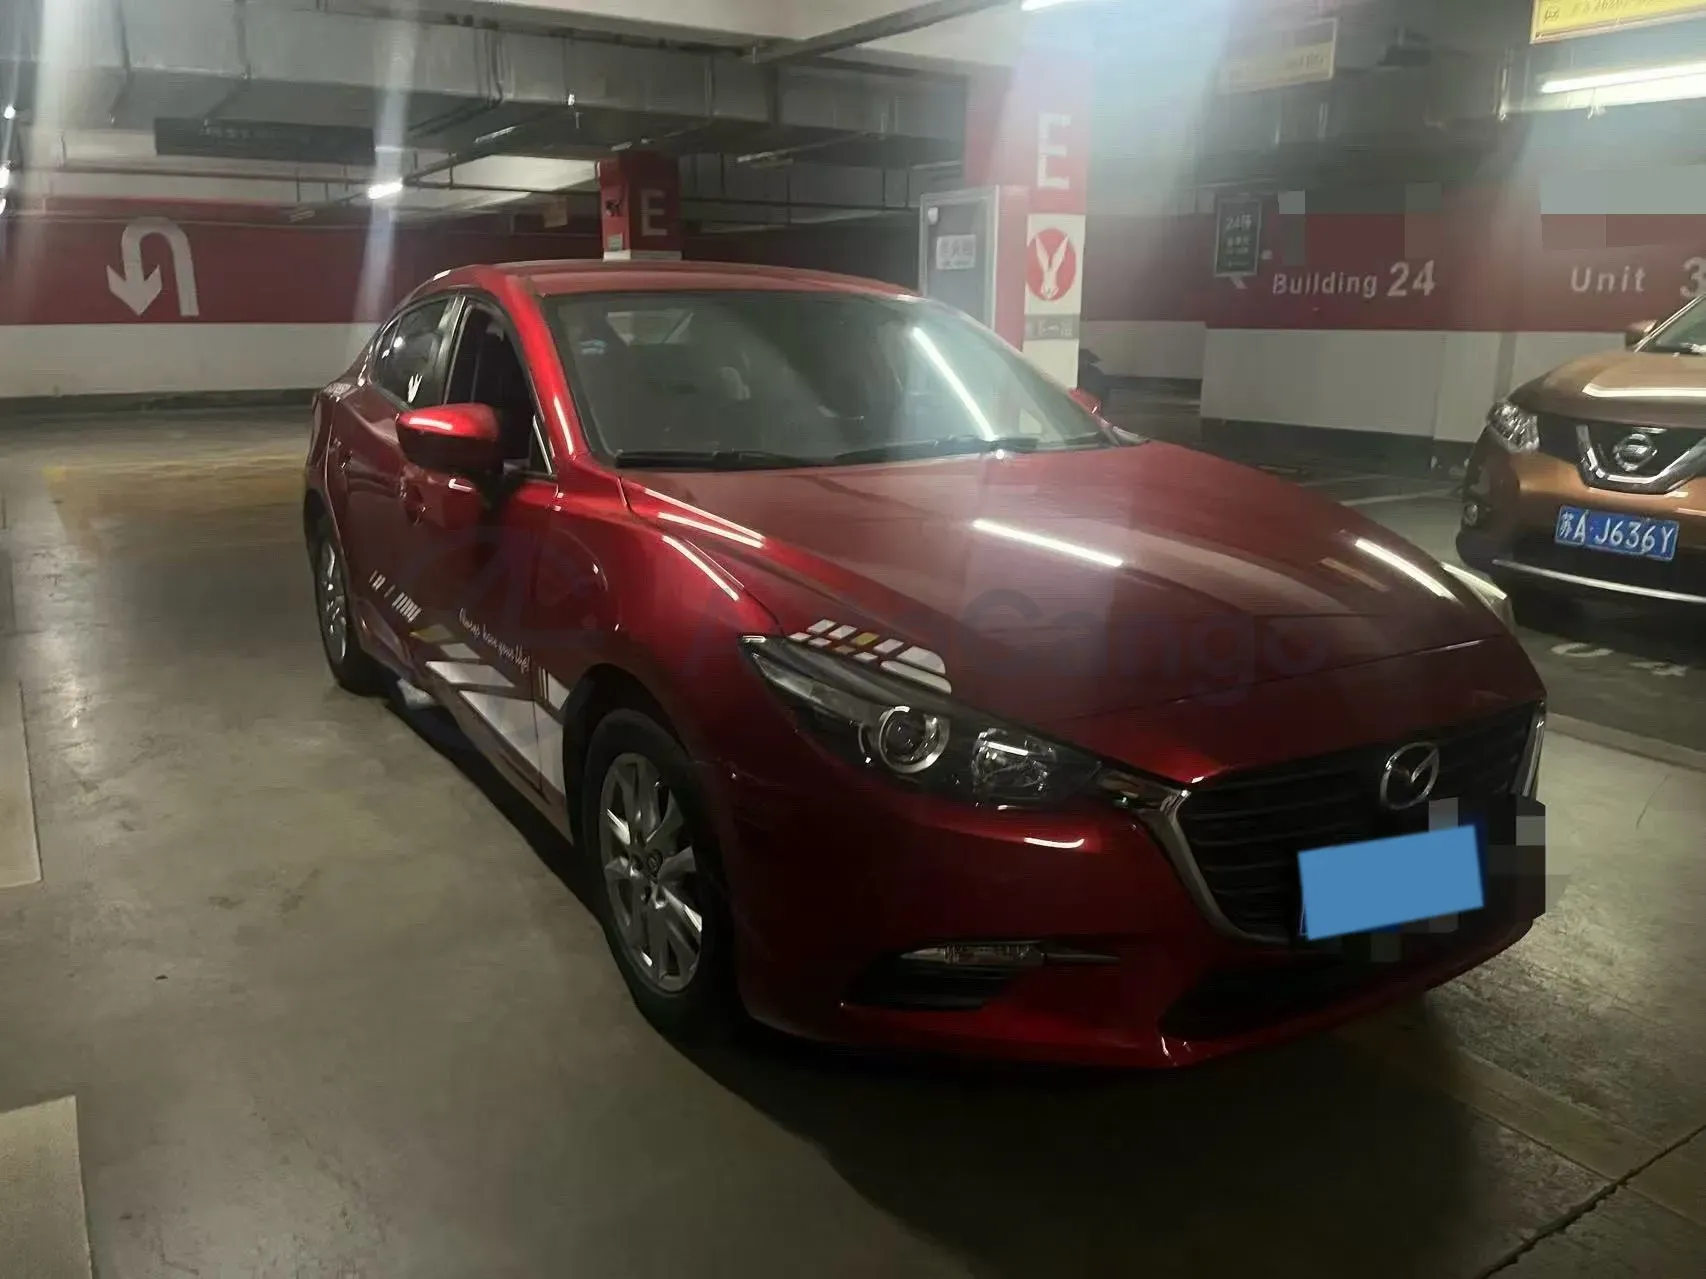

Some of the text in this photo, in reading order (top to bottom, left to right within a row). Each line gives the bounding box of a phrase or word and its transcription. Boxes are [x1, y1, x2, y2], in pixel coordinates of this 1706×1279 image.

[1037, 112, 1071, 189] E
[640, 189, 668, 236] E
[1272, 259, 1436, 298] Building 24
[1570, 265, 1645, 292] Unit
